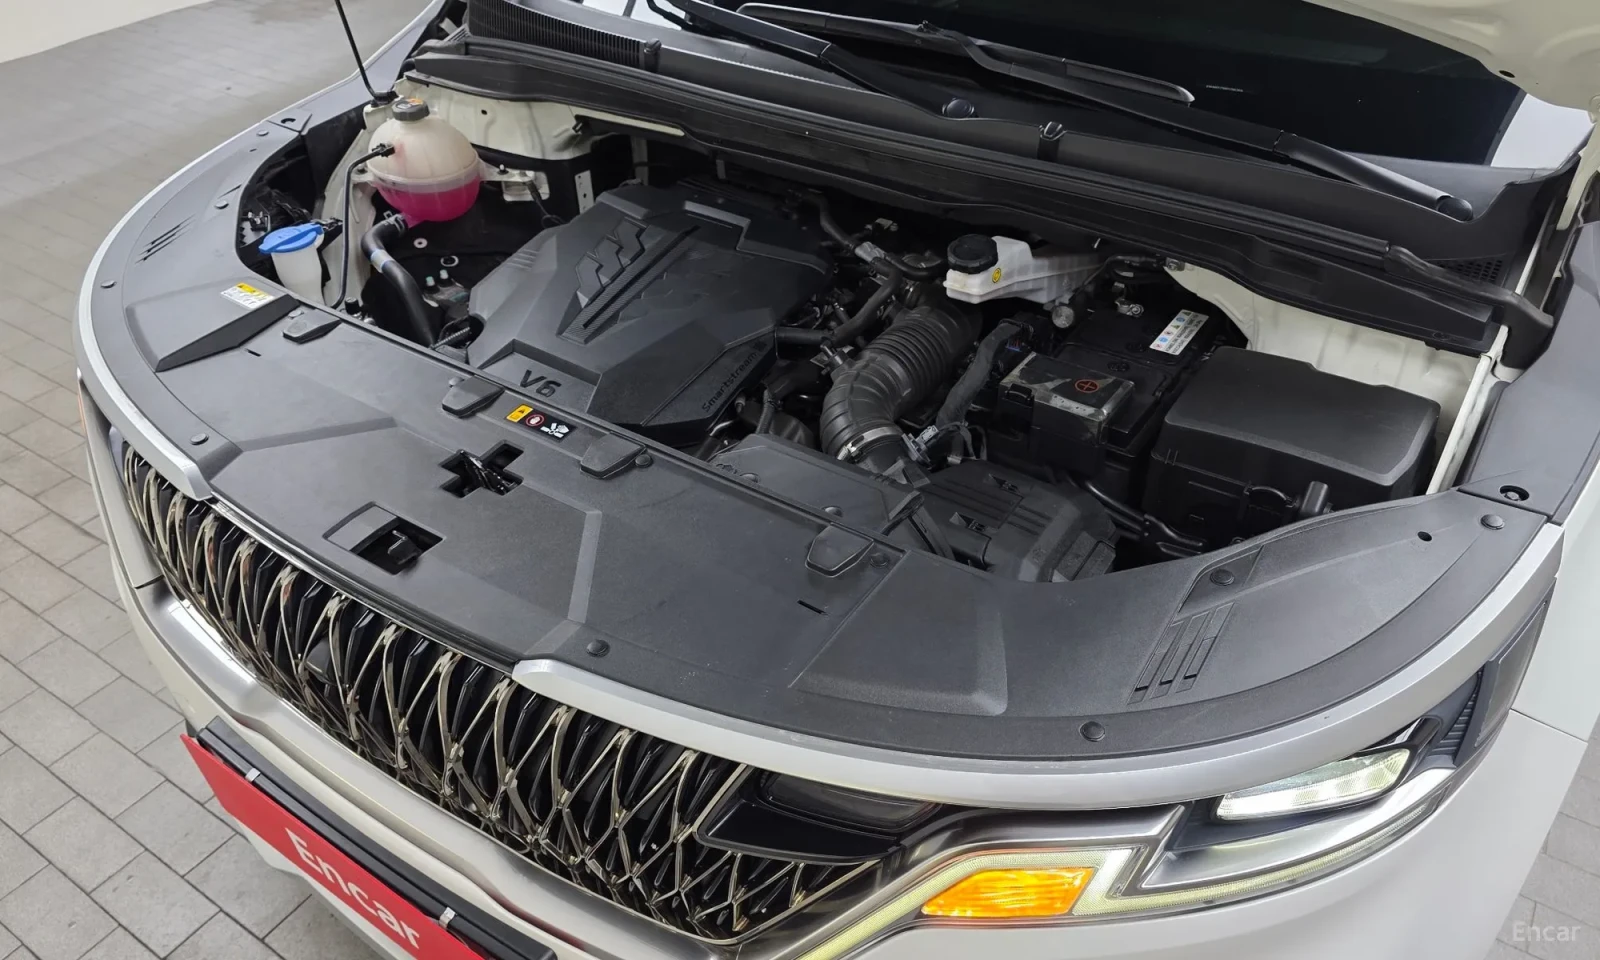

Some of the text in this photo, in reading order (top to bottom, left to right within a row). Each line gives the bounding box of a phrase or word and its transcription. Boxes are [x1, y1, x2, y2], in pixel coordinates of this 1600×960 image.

[520, 369, 562, 398] V6
[702, 352, 757, 413] Smartstream
[285, 827, 420, 950] Encar
